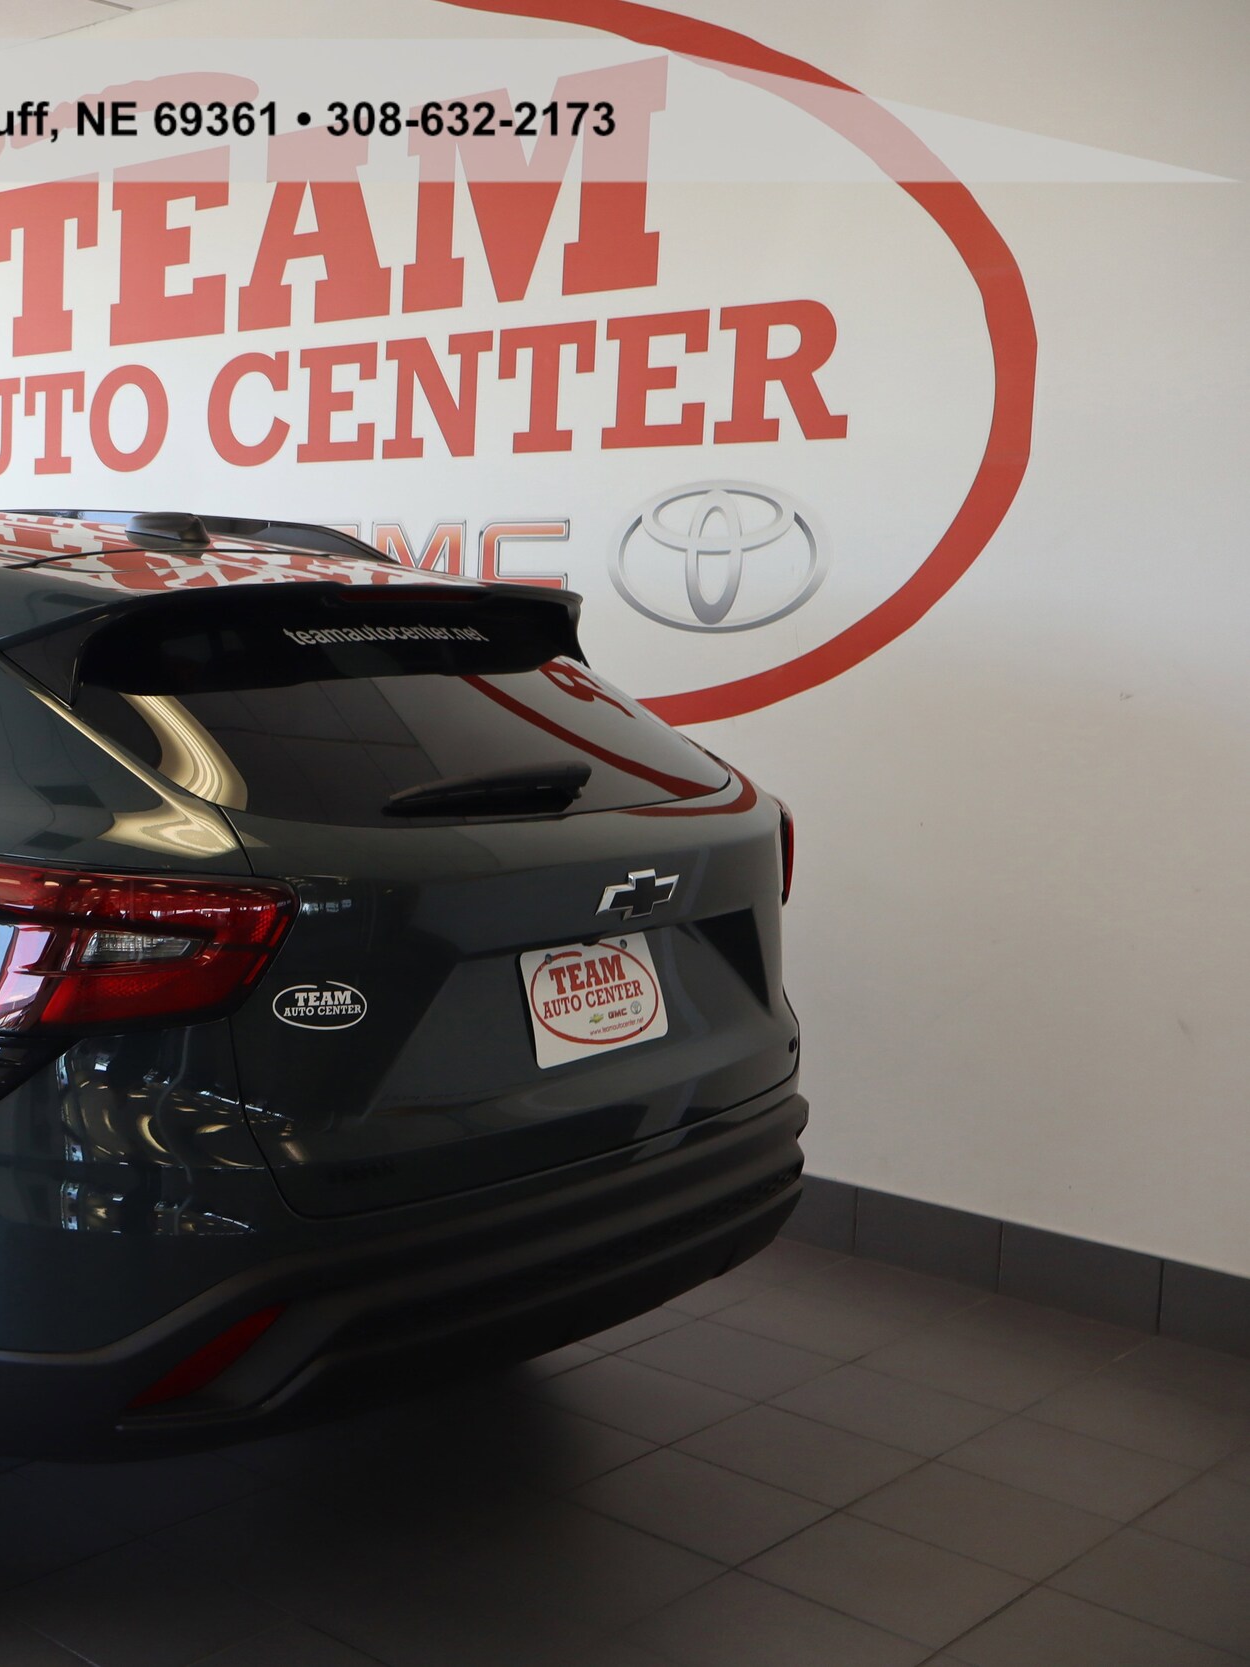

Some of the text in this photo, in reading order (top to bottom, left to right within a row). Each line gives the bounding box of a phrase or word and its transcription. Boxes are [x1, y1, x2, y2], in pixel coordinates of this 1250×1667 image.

[206, 298, 849, 467] CENTER
[283, 624, 490, 646] teamautocenter.net
[549, 954, 626, 995] TEAM
[295, 990, 352, 1006] TEAM
[543, 980, 644, 1019] AUTO CENTER
[284, 1004, 362, 1017] AUTO CENTER
[608, 1008, 628, 1019] GMC
